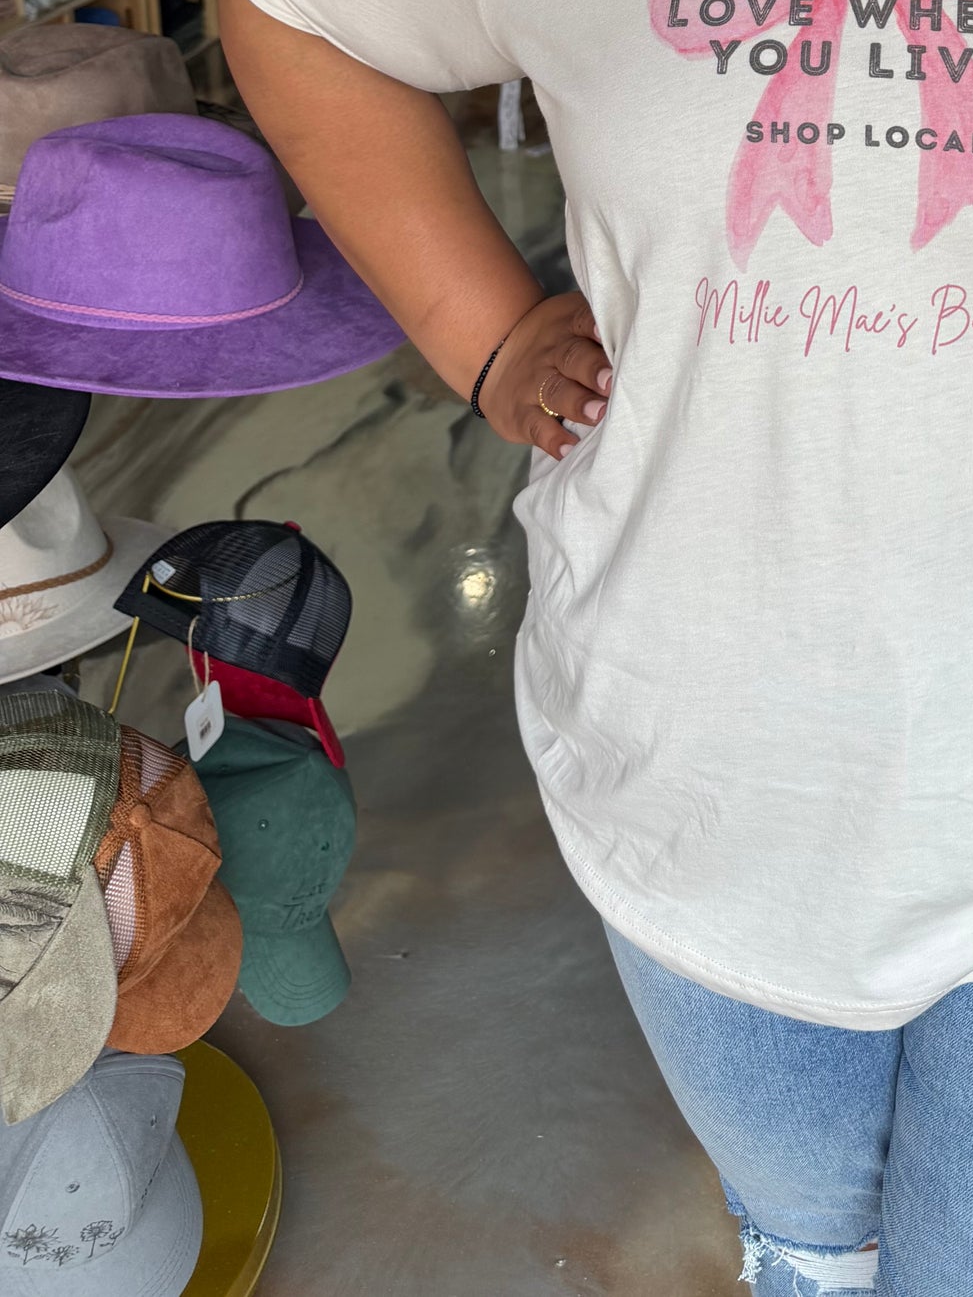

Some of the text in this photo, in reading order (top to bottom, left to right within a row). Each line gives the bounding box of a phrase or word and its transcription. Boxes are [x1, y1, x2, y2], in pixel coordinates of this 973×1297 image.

[709, 39, 832, 77] YOU
[746, 121, 846, 145] SHOP
[695, 277, 789, 347] Millie
[799, 285, 918, 357] Mae's
